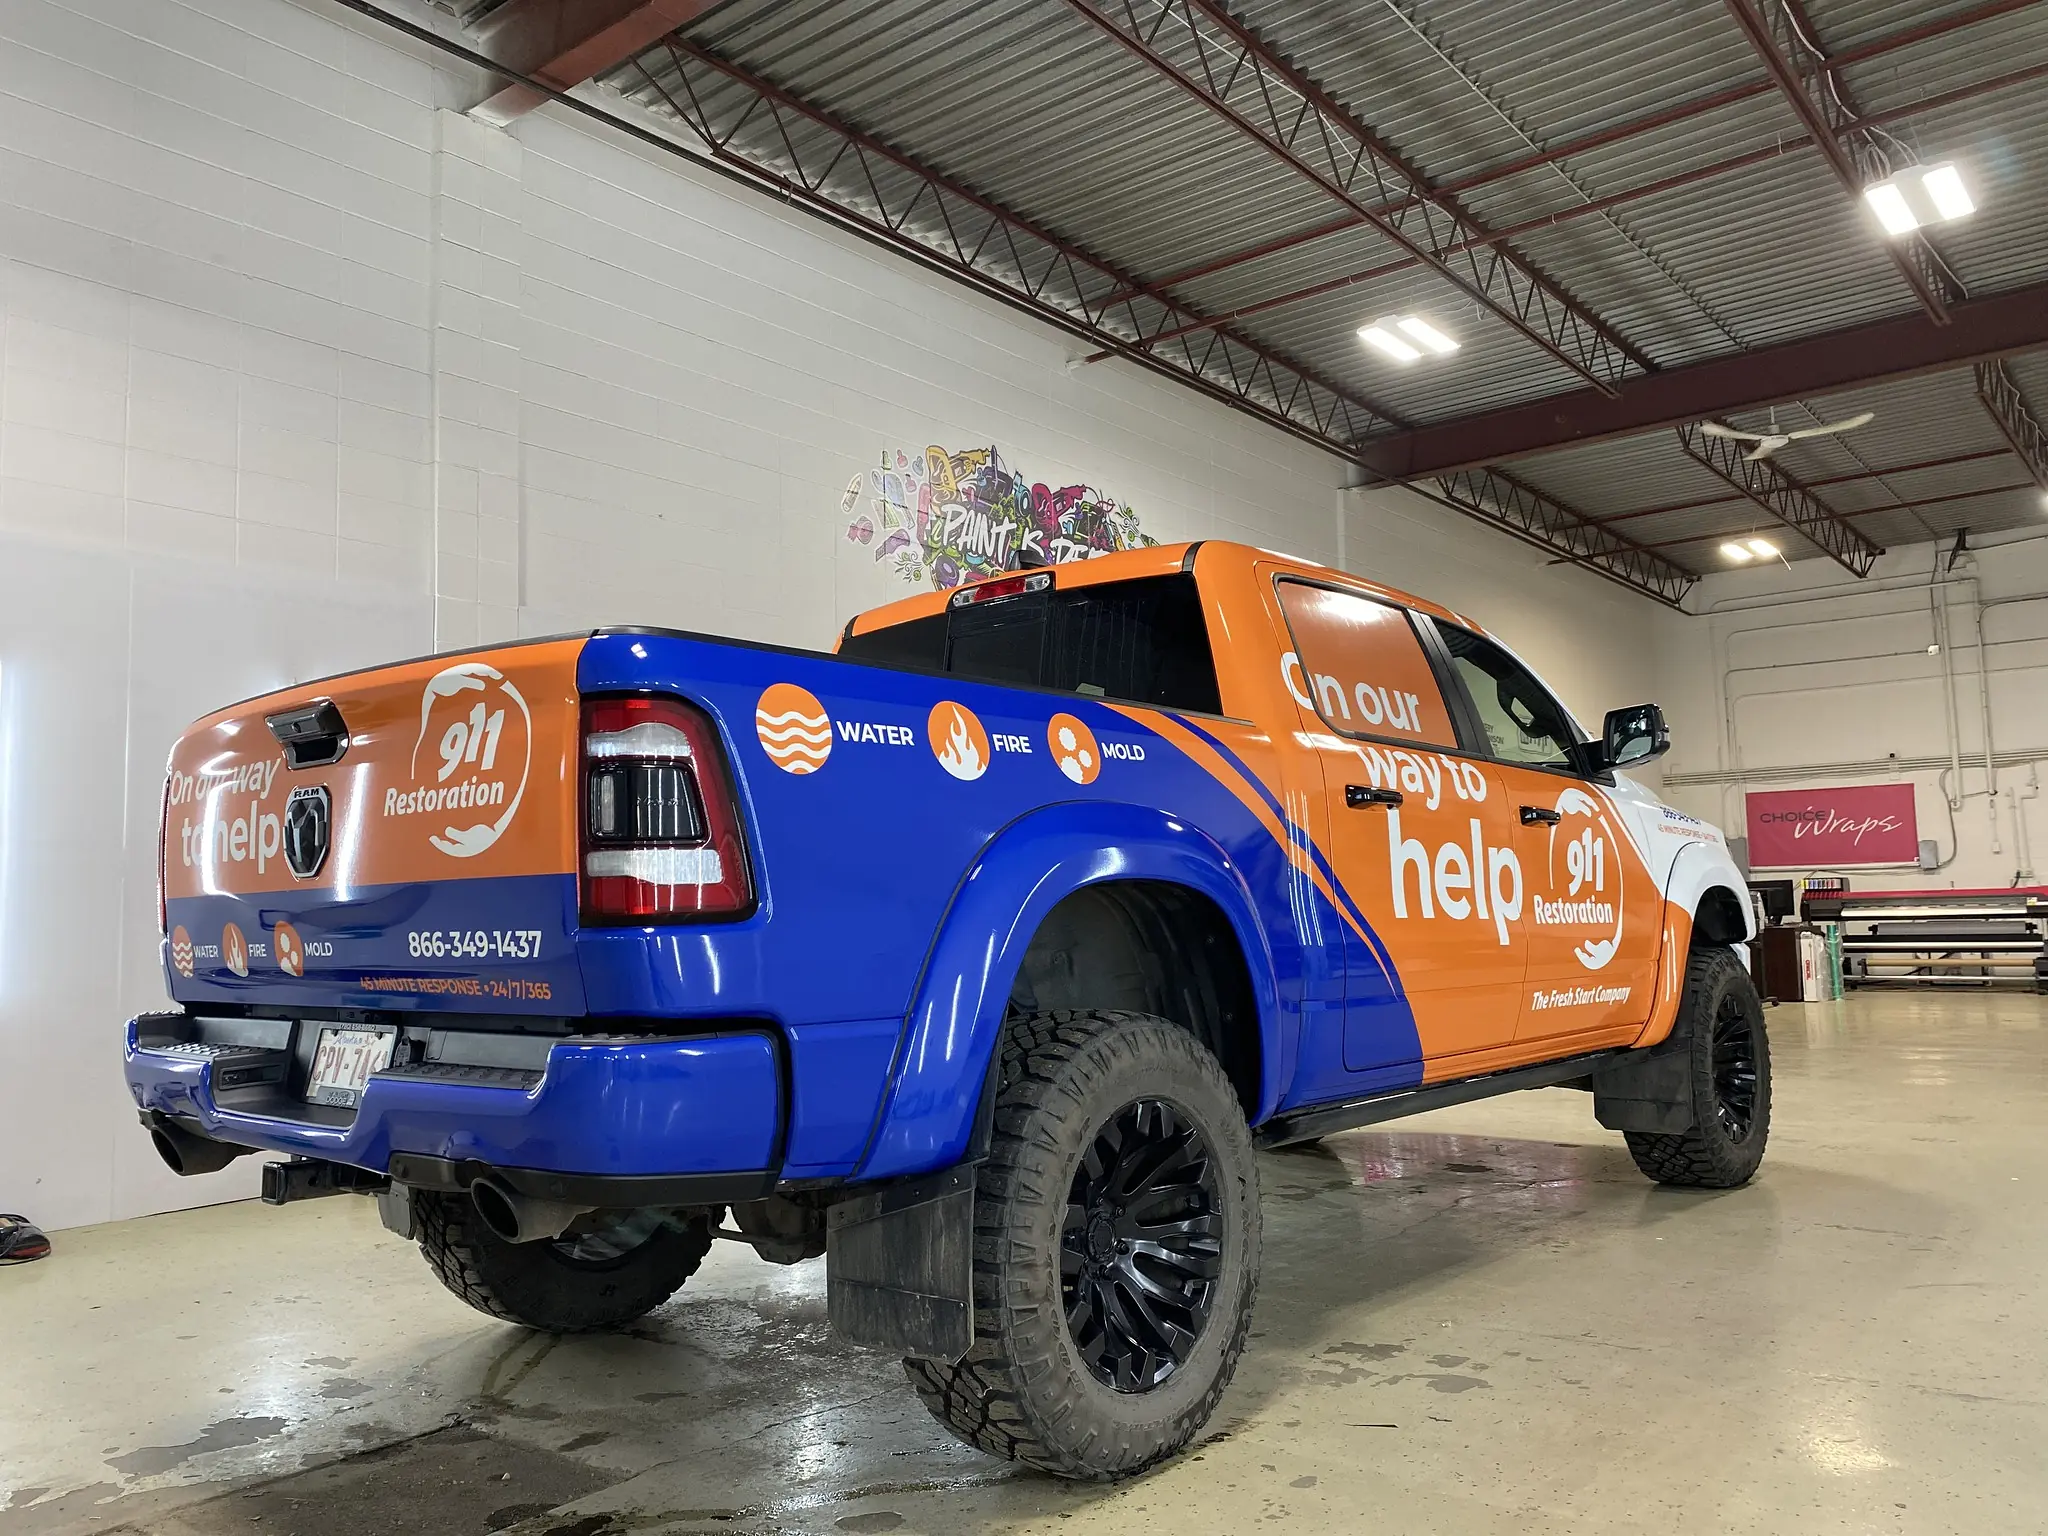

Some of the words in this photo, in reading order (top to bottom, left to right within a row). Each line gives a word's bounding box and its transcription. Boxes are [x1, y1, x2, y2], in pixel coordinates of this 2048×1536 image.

[940, 503, 1017, 564] PAINT
[1355, 682, 1422, 733] our
[437, 702, 505, 783] 911
[836, 720, 915, 747] WATER
[992, 733, 1033, 754] FIRE
[1102, 744, 1146, 762] MOLD
[170, 770, 192, 806] On
[229, 757, 282, 800] way
[294, 787, 320, 799] RAM
[383, 775, 505, 817] Restoration
[1357, 746, 1442, 811] way
[1439, 754, 1487, 803] to
[212, 800, 281, 875] help
[1760, 810, 1827, 824] CHOICE
[1793, 806, 1903, 847] Wraps
[1387, 808, 1524, 946] help
[1567, 827, 1604, 897] 911
[1533, 894, 1613, 924] Restoration
[193, 944, 219, 959] WATER
[248, 943, 268, 957] FIRE
[304, 942, 333, 957] MOLD
[408, 930, 543, 958] 866-349-1437
[360, 976, 374, 990] 45
[374, 976, 418, 993] MINUTE
[417, 978, 483, 997] RESPONSE
[1531, 990, 1549, 1011] The
[1548, 987, 1574, 1009] Fresh
[1573, 986, 1597, 1006] Start
[1595, 985, 1632, 1006] Company
